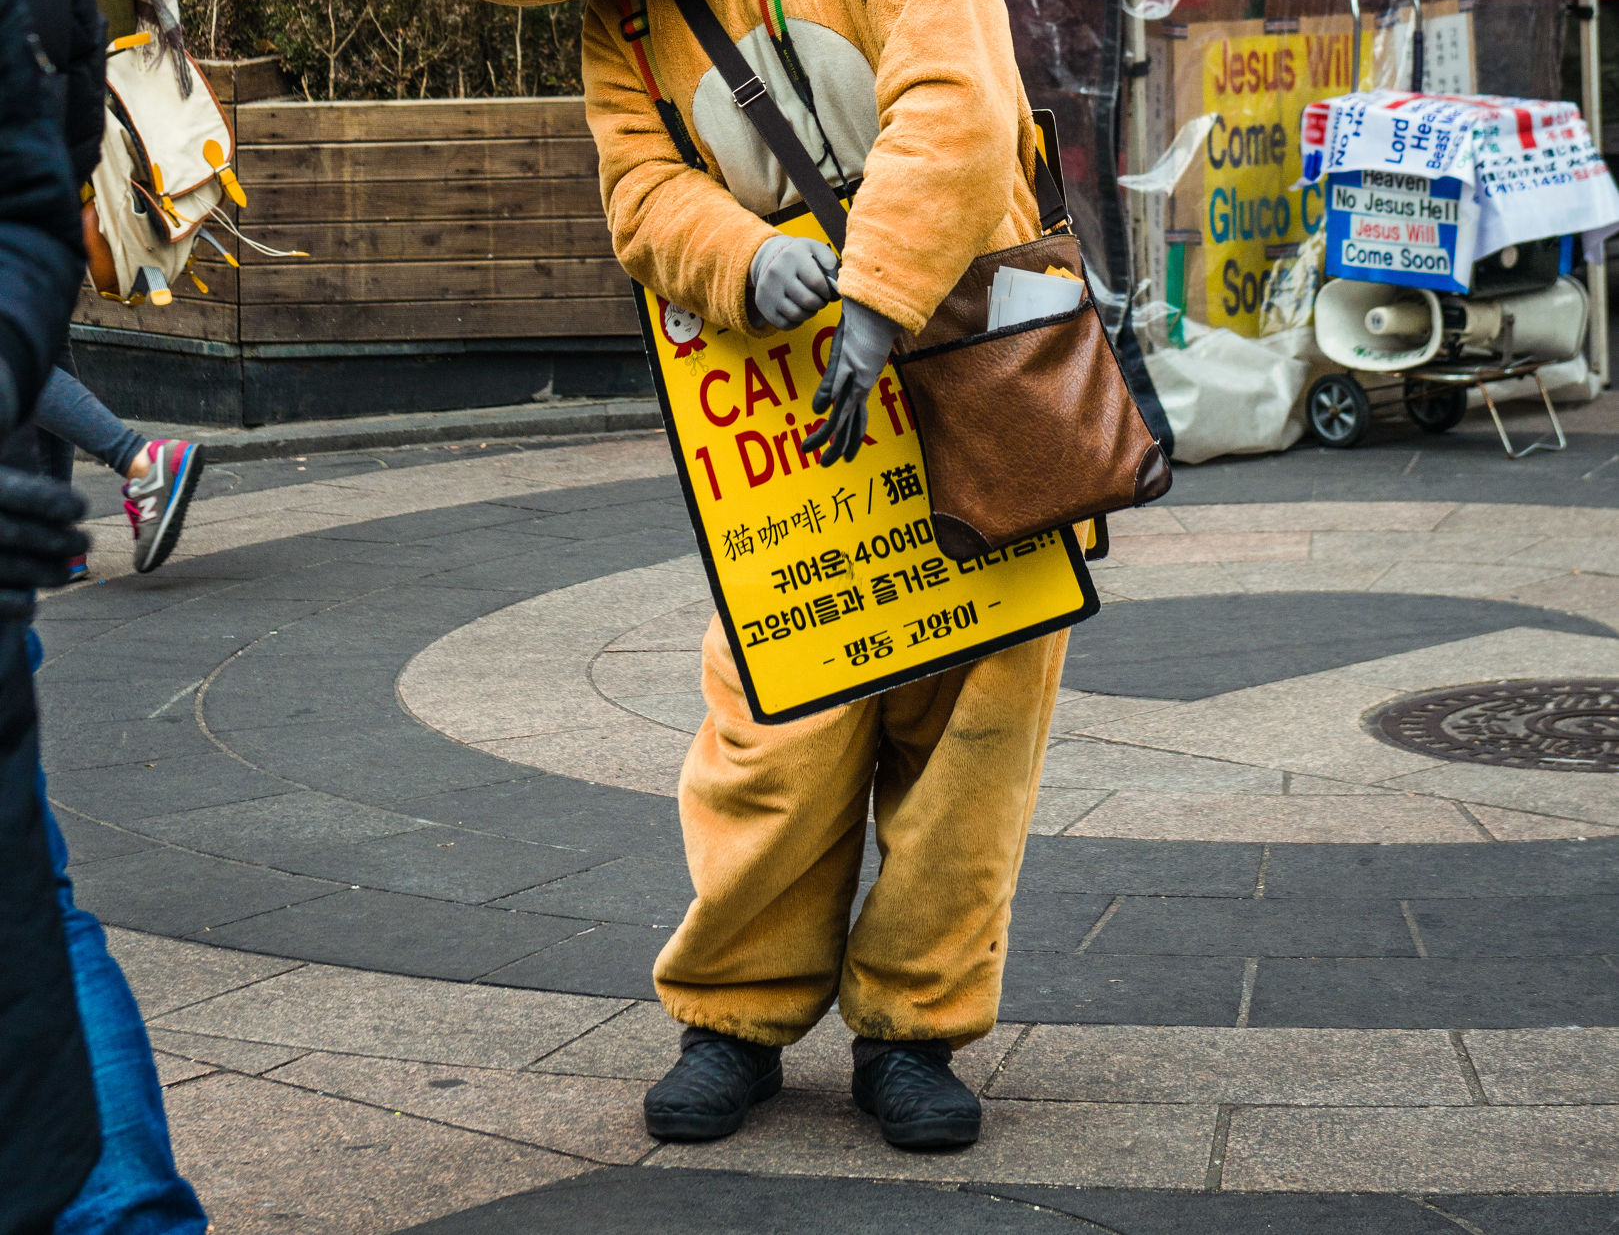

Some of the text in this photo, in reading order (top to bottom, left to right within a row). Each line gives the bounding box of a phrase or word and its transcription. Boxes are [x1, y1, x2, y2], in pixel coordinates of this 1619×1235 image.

[1215, 39, 1296, 95] Jesus
[1207, 115, 1286, 170] Come
[1385, 117, 1409, 164] Lord
[1335, 187, 1459, 222] No Jesus Hell
[1362, 169, 1429, 194] Heaven
[1209, 186, 1291, 244] Gluco
[1355, 218, 1436, 243] Jesus Will
[1344, 243, 1449, 271] Come Soon
[699, 342, 799, 428] CAT
[695, 445, 722, 502] 1
[770, 549, 847, 594] 귀여운
[741, 556, 951, 649] 고양이들과 즐거운
[843, 630, 894, 667] 명동
[902, 600, 979, 649] 고양이
